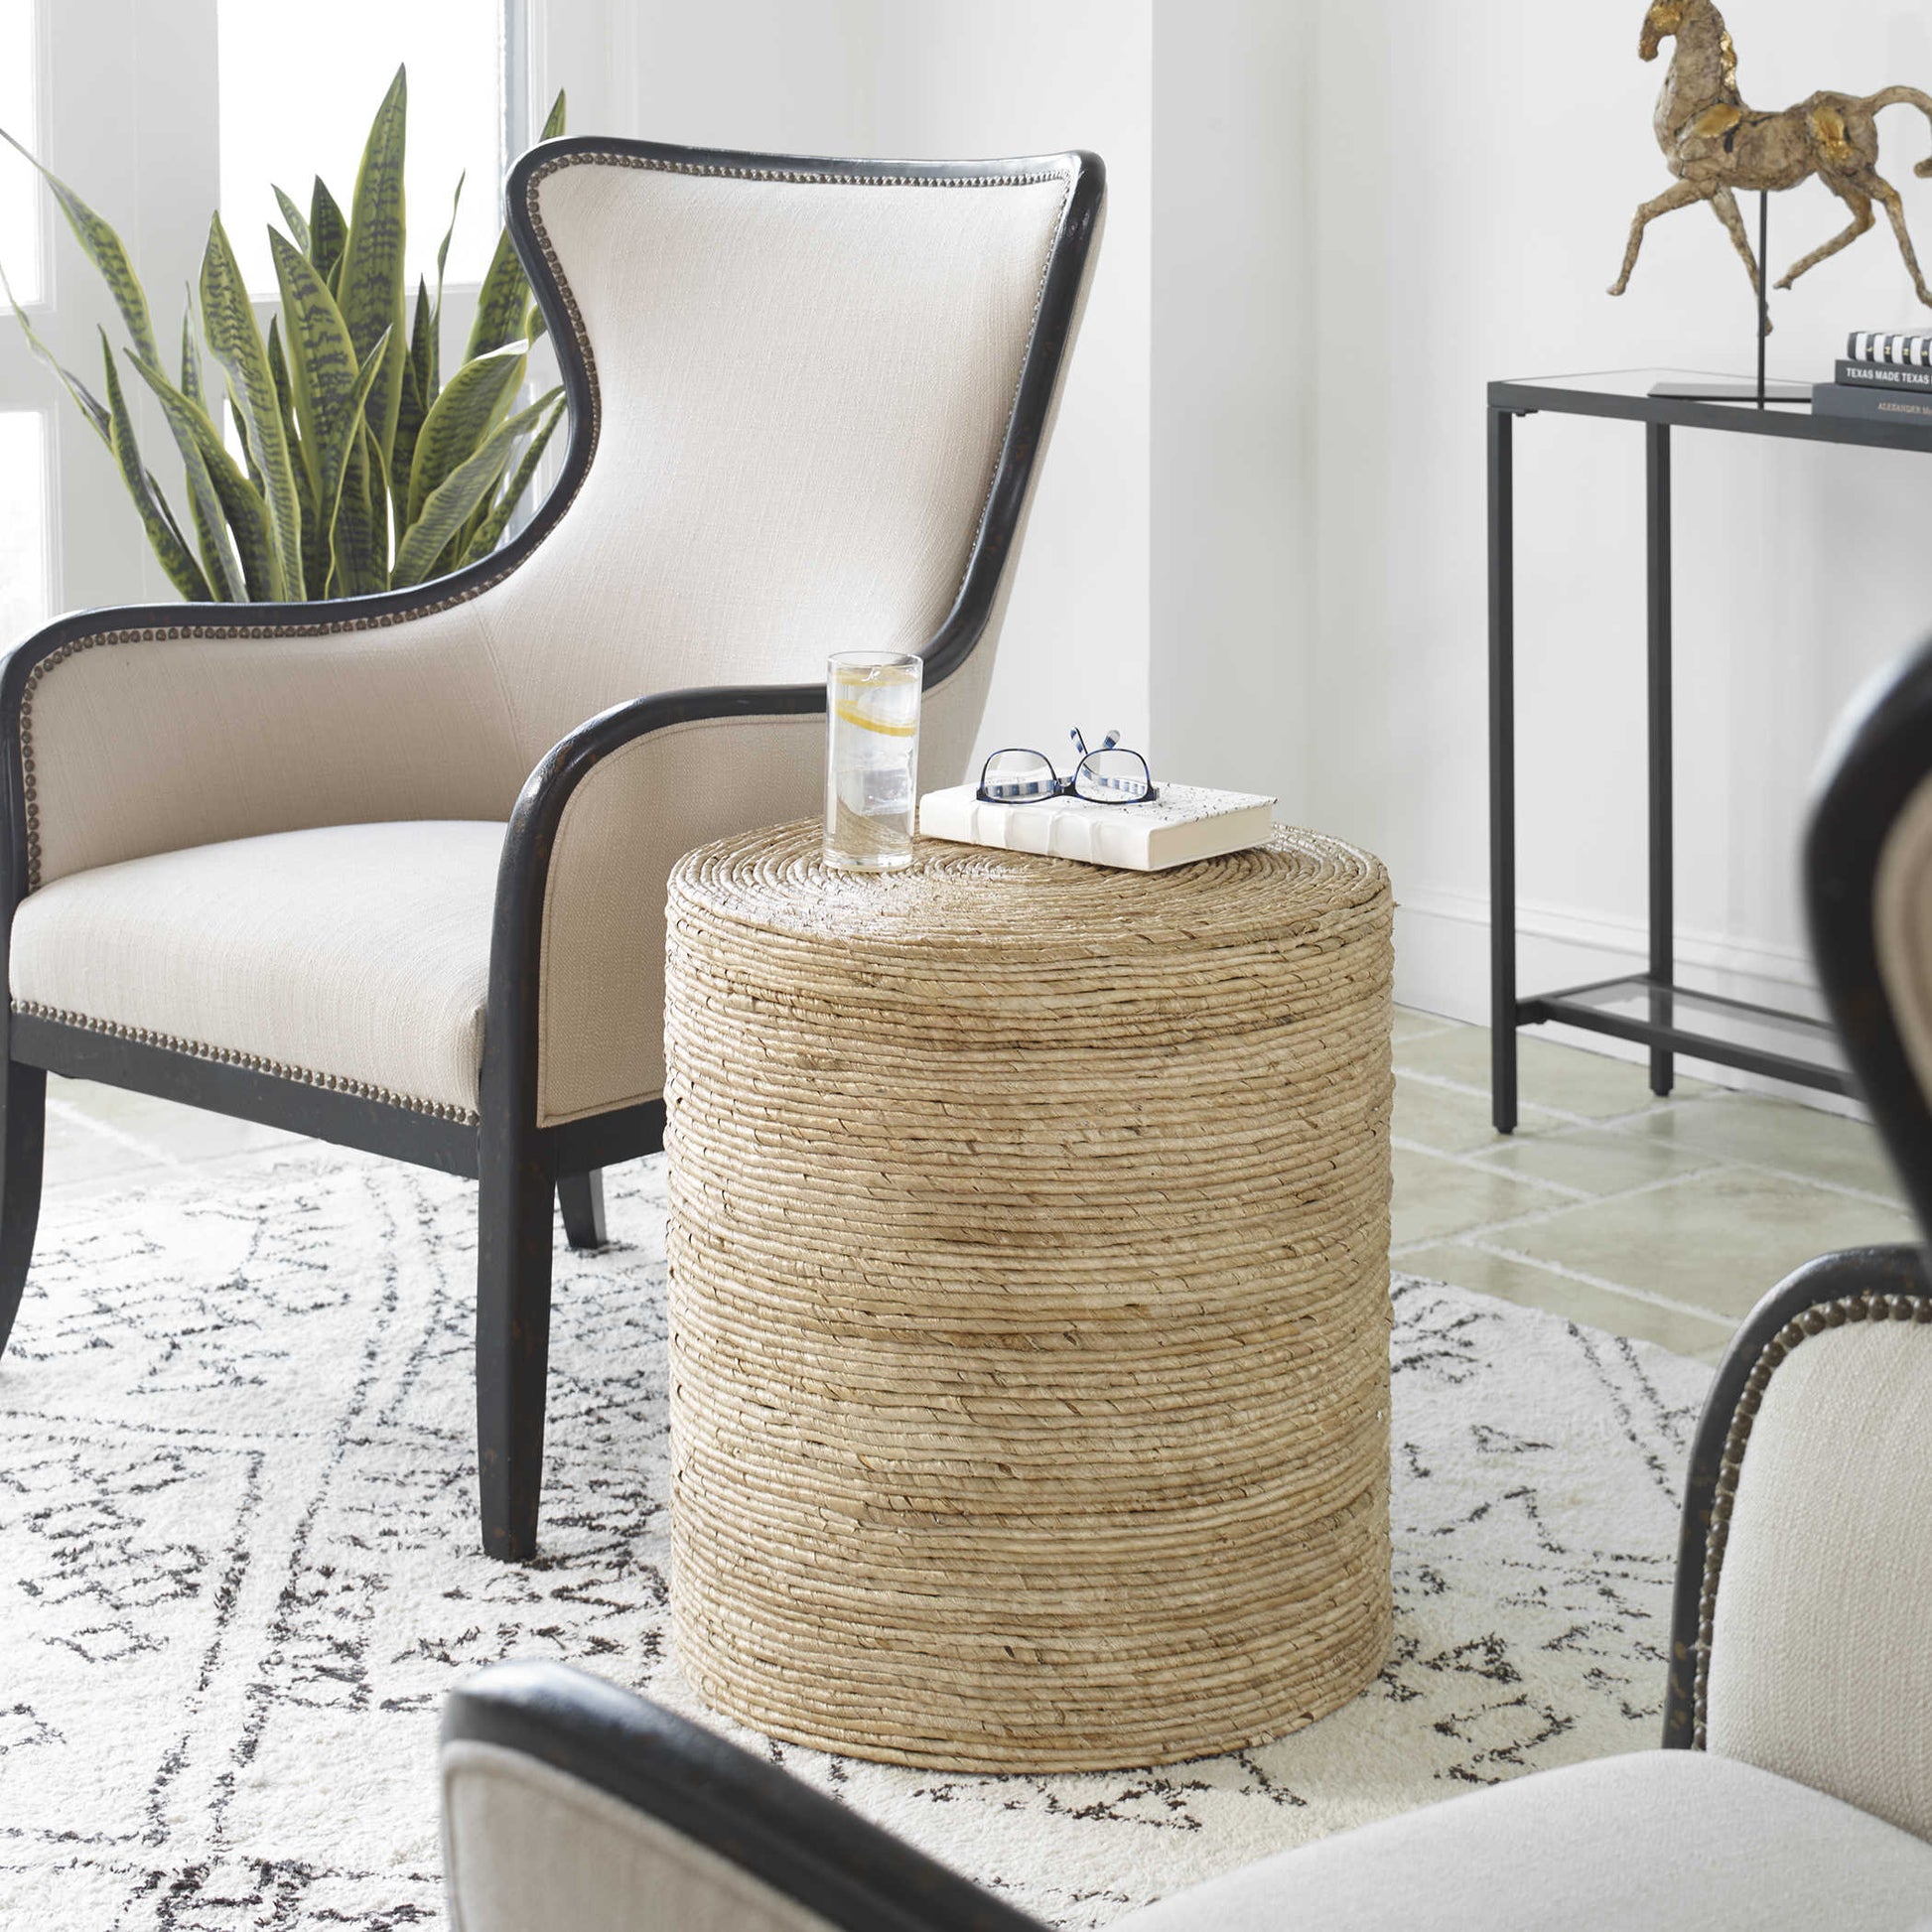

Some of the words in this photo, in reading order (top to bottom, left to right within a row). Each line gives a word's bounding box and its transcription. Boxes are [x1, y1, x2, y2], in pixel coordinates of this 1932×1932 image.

[1846, 367, 1873, 379] TEXAS
[1874, 370, 1900, 382] MADE
[1901, 372, 1930, 384] TEXAS
